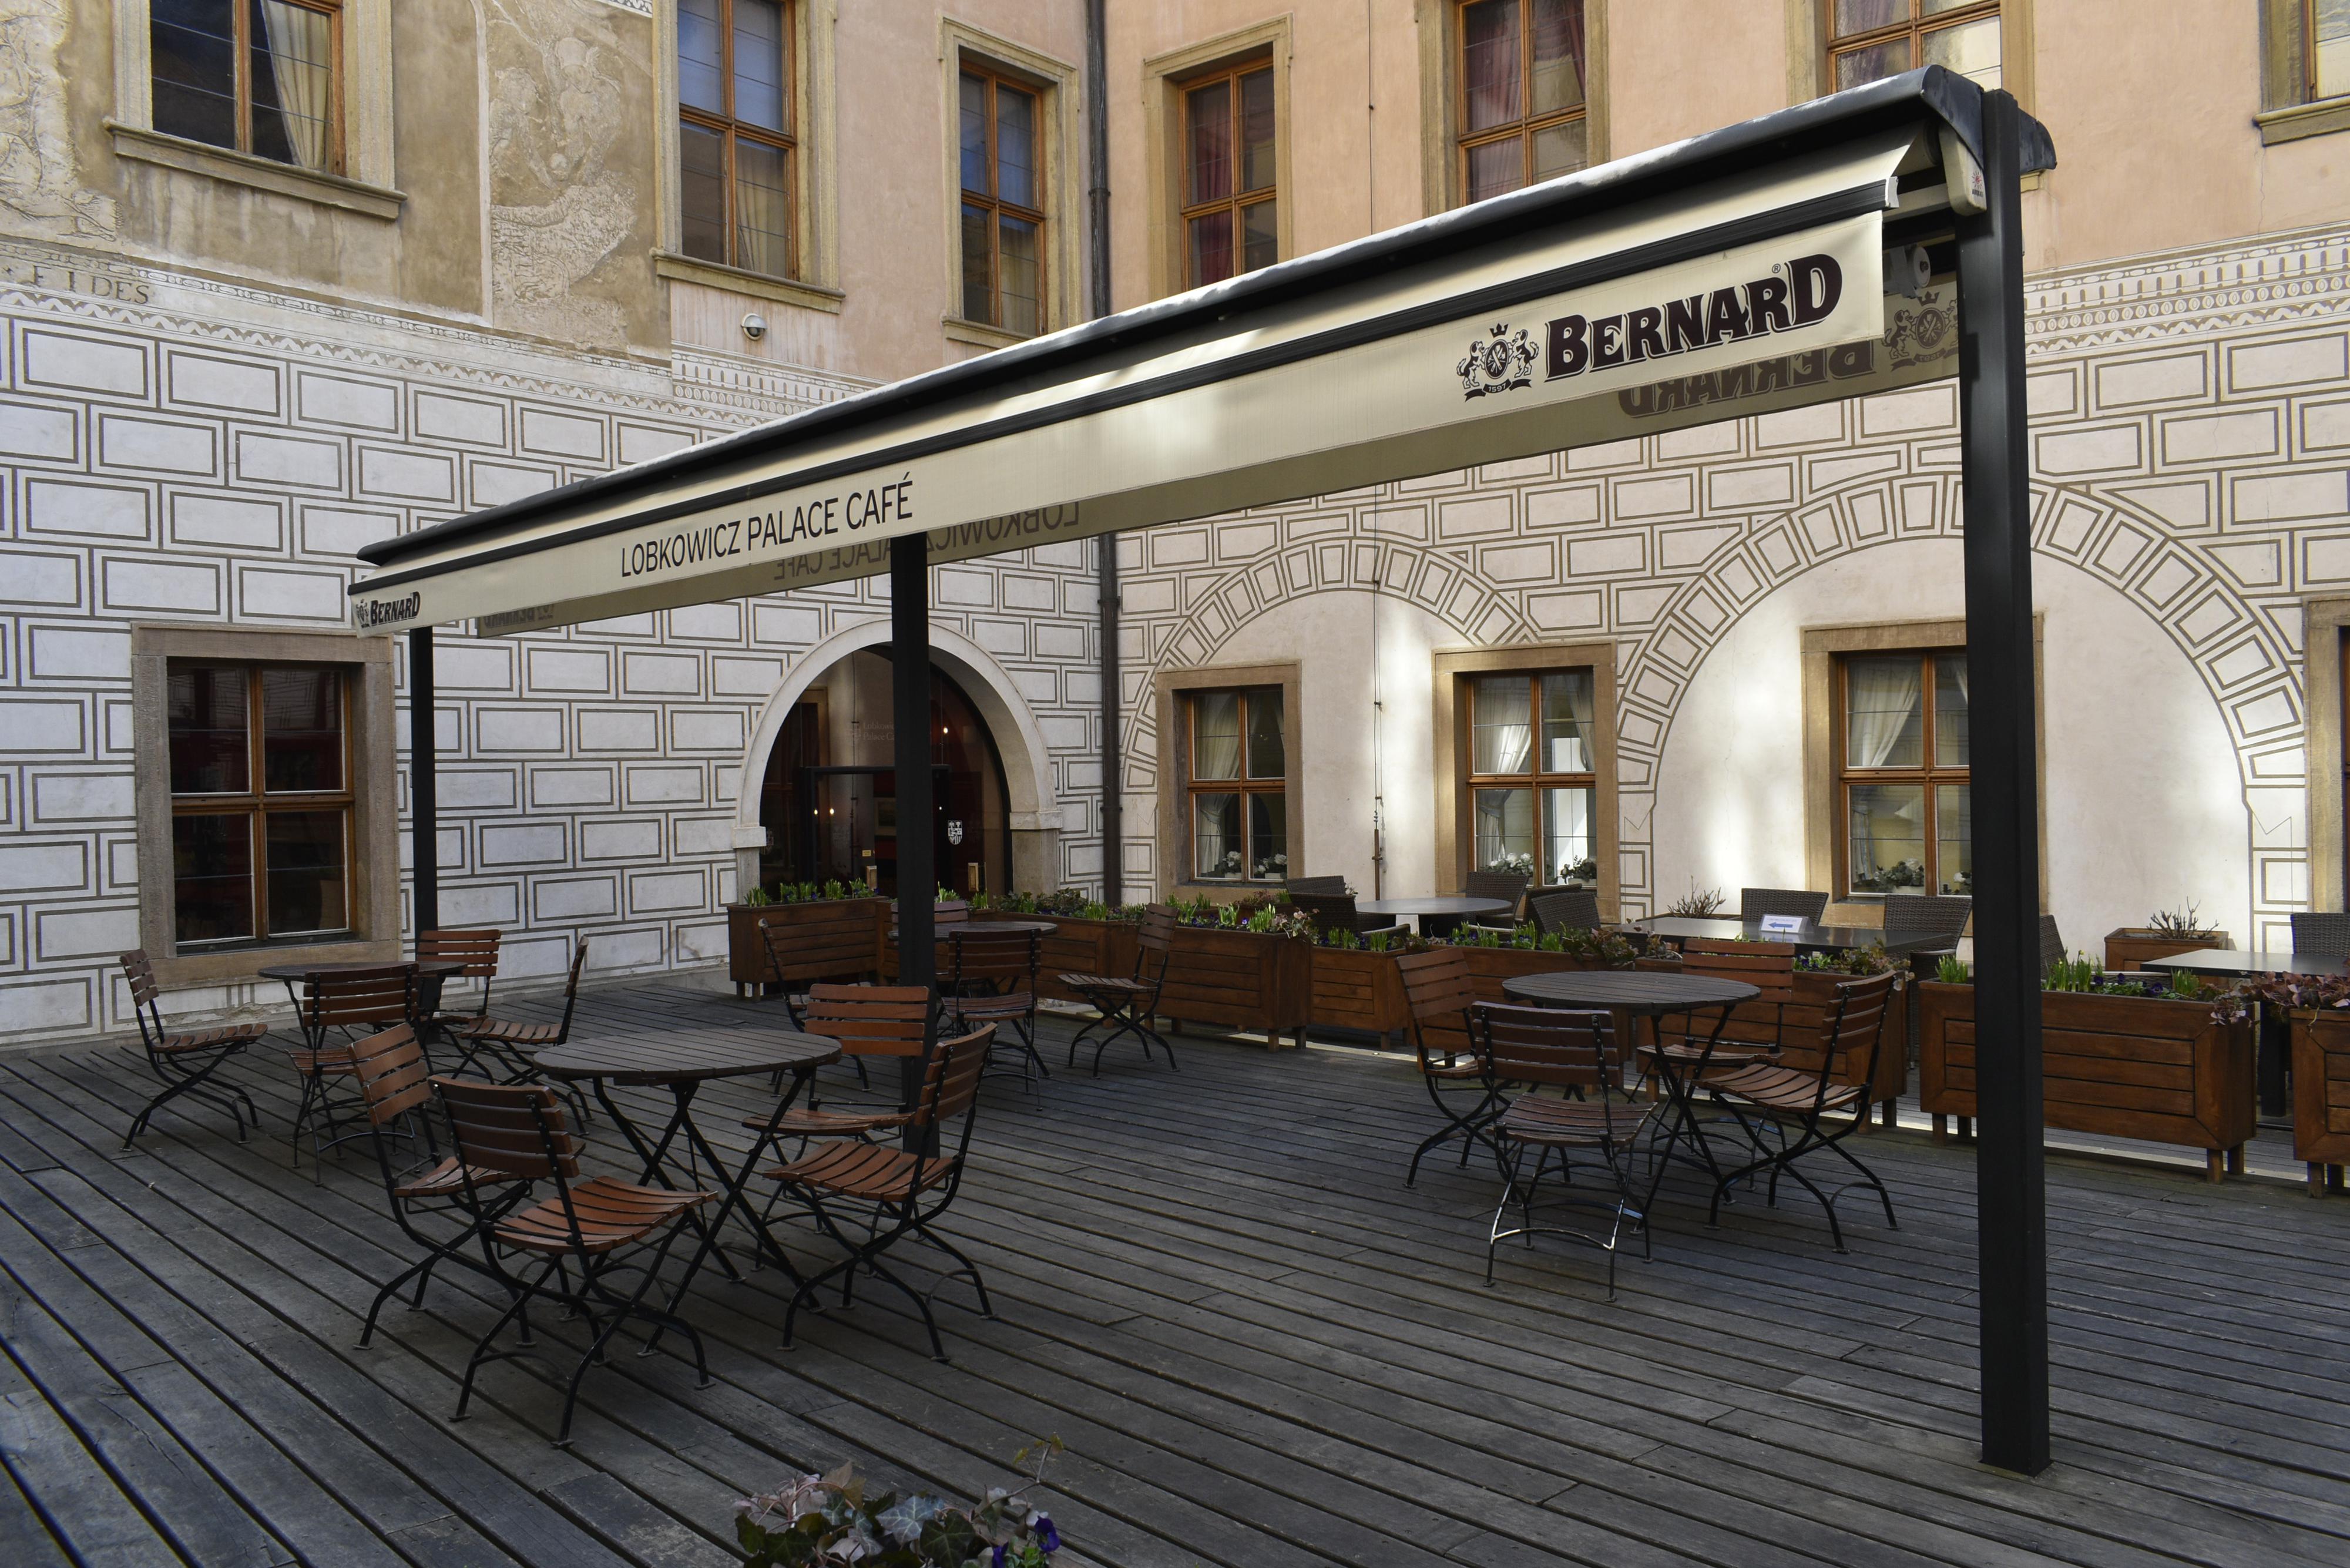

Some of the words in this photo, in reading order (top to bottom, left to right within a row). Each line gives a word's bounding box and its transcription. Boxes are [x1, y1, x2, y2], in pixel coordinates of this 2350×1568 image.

[1543, 253, 1843, 383] BERNARD
[1488, 382, 1507, 392] 1597
[622, 521, 741, 577] LOBKOWICZ
[748, 497, 839, 551] PALACE
[846, 471, 914, 530] CAFÉ
[371, 591, 421, 626] BERNARD
